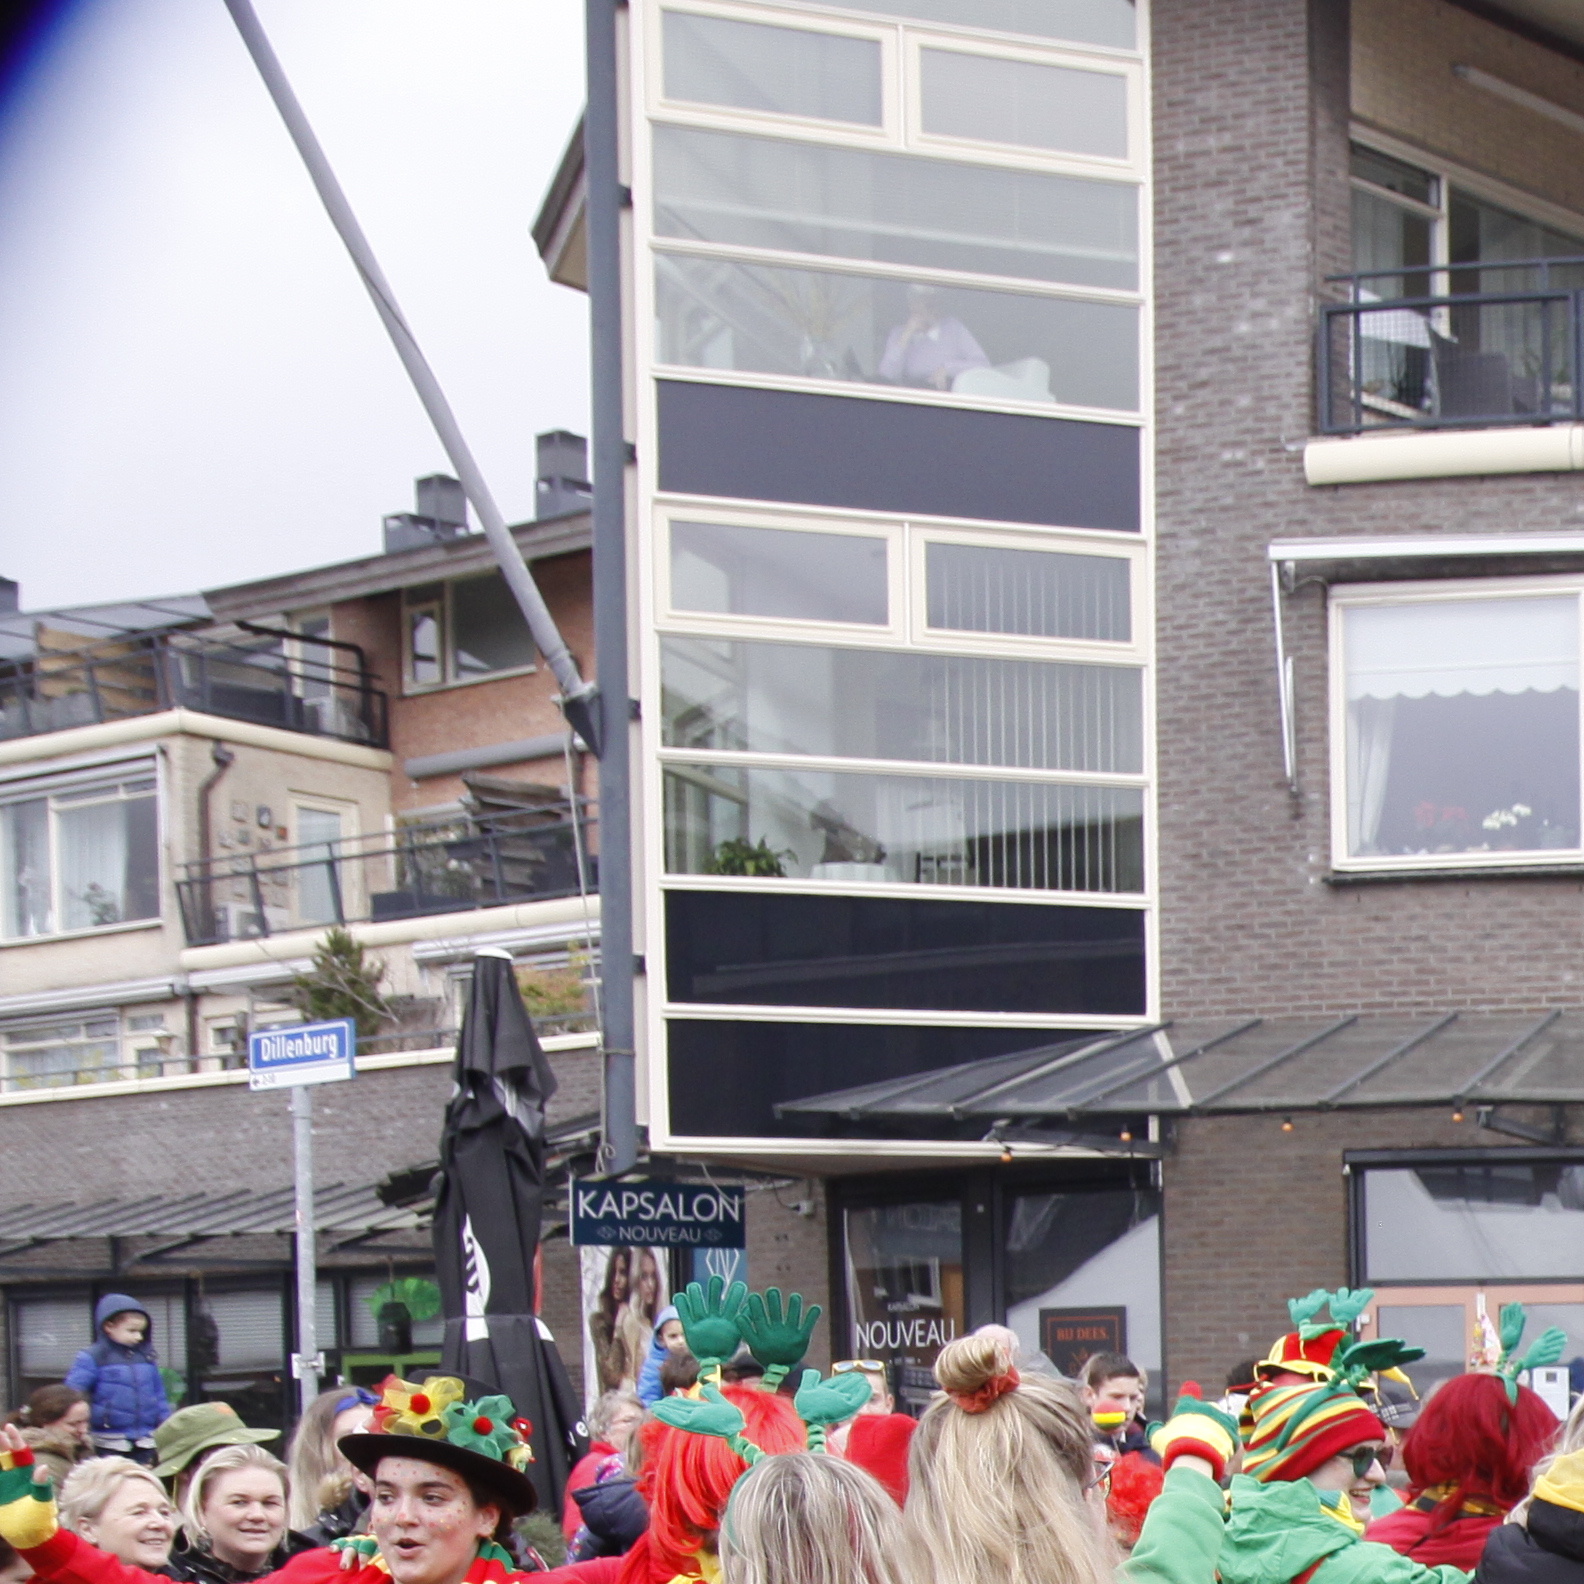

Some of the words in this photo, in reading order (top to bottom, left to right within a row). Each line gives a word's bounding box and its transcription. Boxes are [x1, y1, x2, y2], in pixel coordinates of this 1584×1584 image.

[261, 1031, 338, 1061] Dillenburg
[578, 1189, 740, 1222] KAPSALON
[619, 1226, 700, 1243] NOUVEAU
[856, 1318, 955, 1350] NOUVEAU
